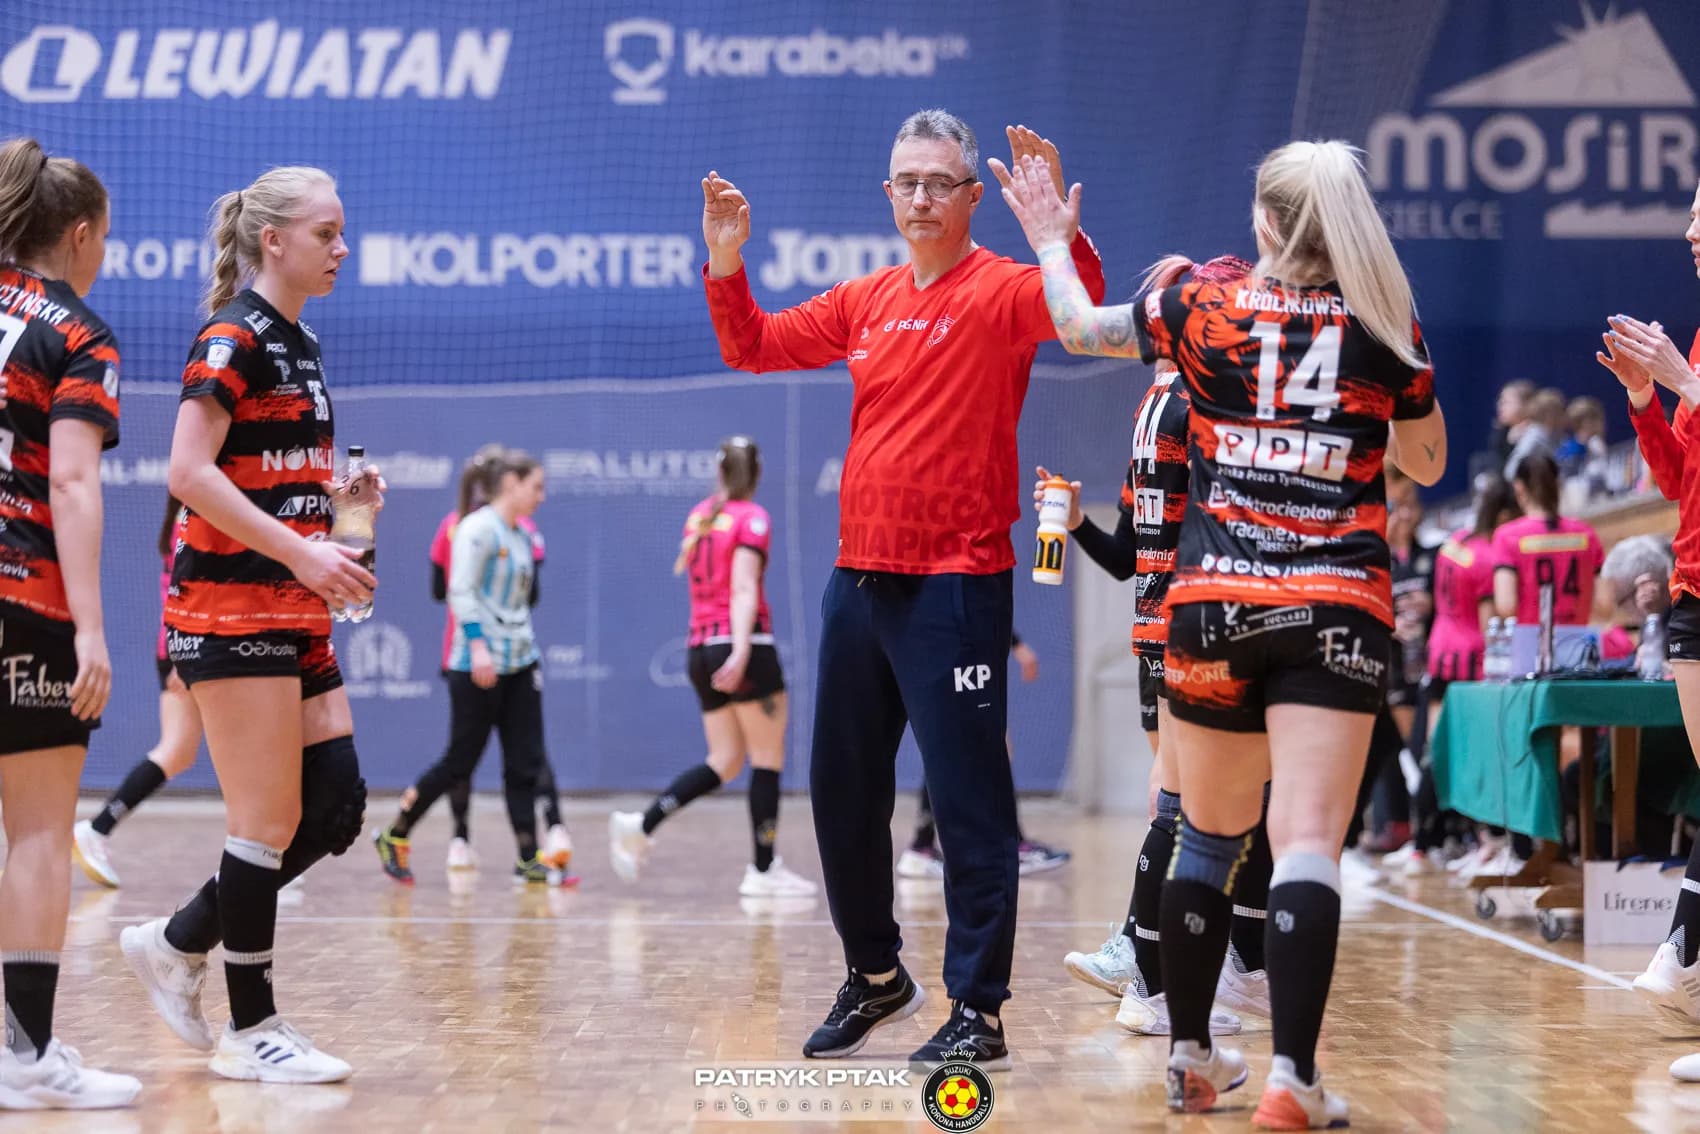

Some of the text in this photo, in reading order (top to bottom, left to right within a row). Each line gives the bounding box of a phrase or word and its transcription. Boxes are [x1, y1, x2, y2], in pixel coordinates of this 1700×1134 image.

[103, 19, 511, 99] LEWIATAN
[684, 30, 936, 77] karabela
[1381, 199, 1503, 240] IELCE
[101, 239, 210, 279] ROFI
[396, 233, 694, 287] KOLPORTER
[1249, 321, 1342, 422] 14
[1219, 428, 1347, 475] PPT
[167, 629, 205, 653] aber
[953, 664, 992, 692] KP
[1603, 891, 1673, 911] Lirene
